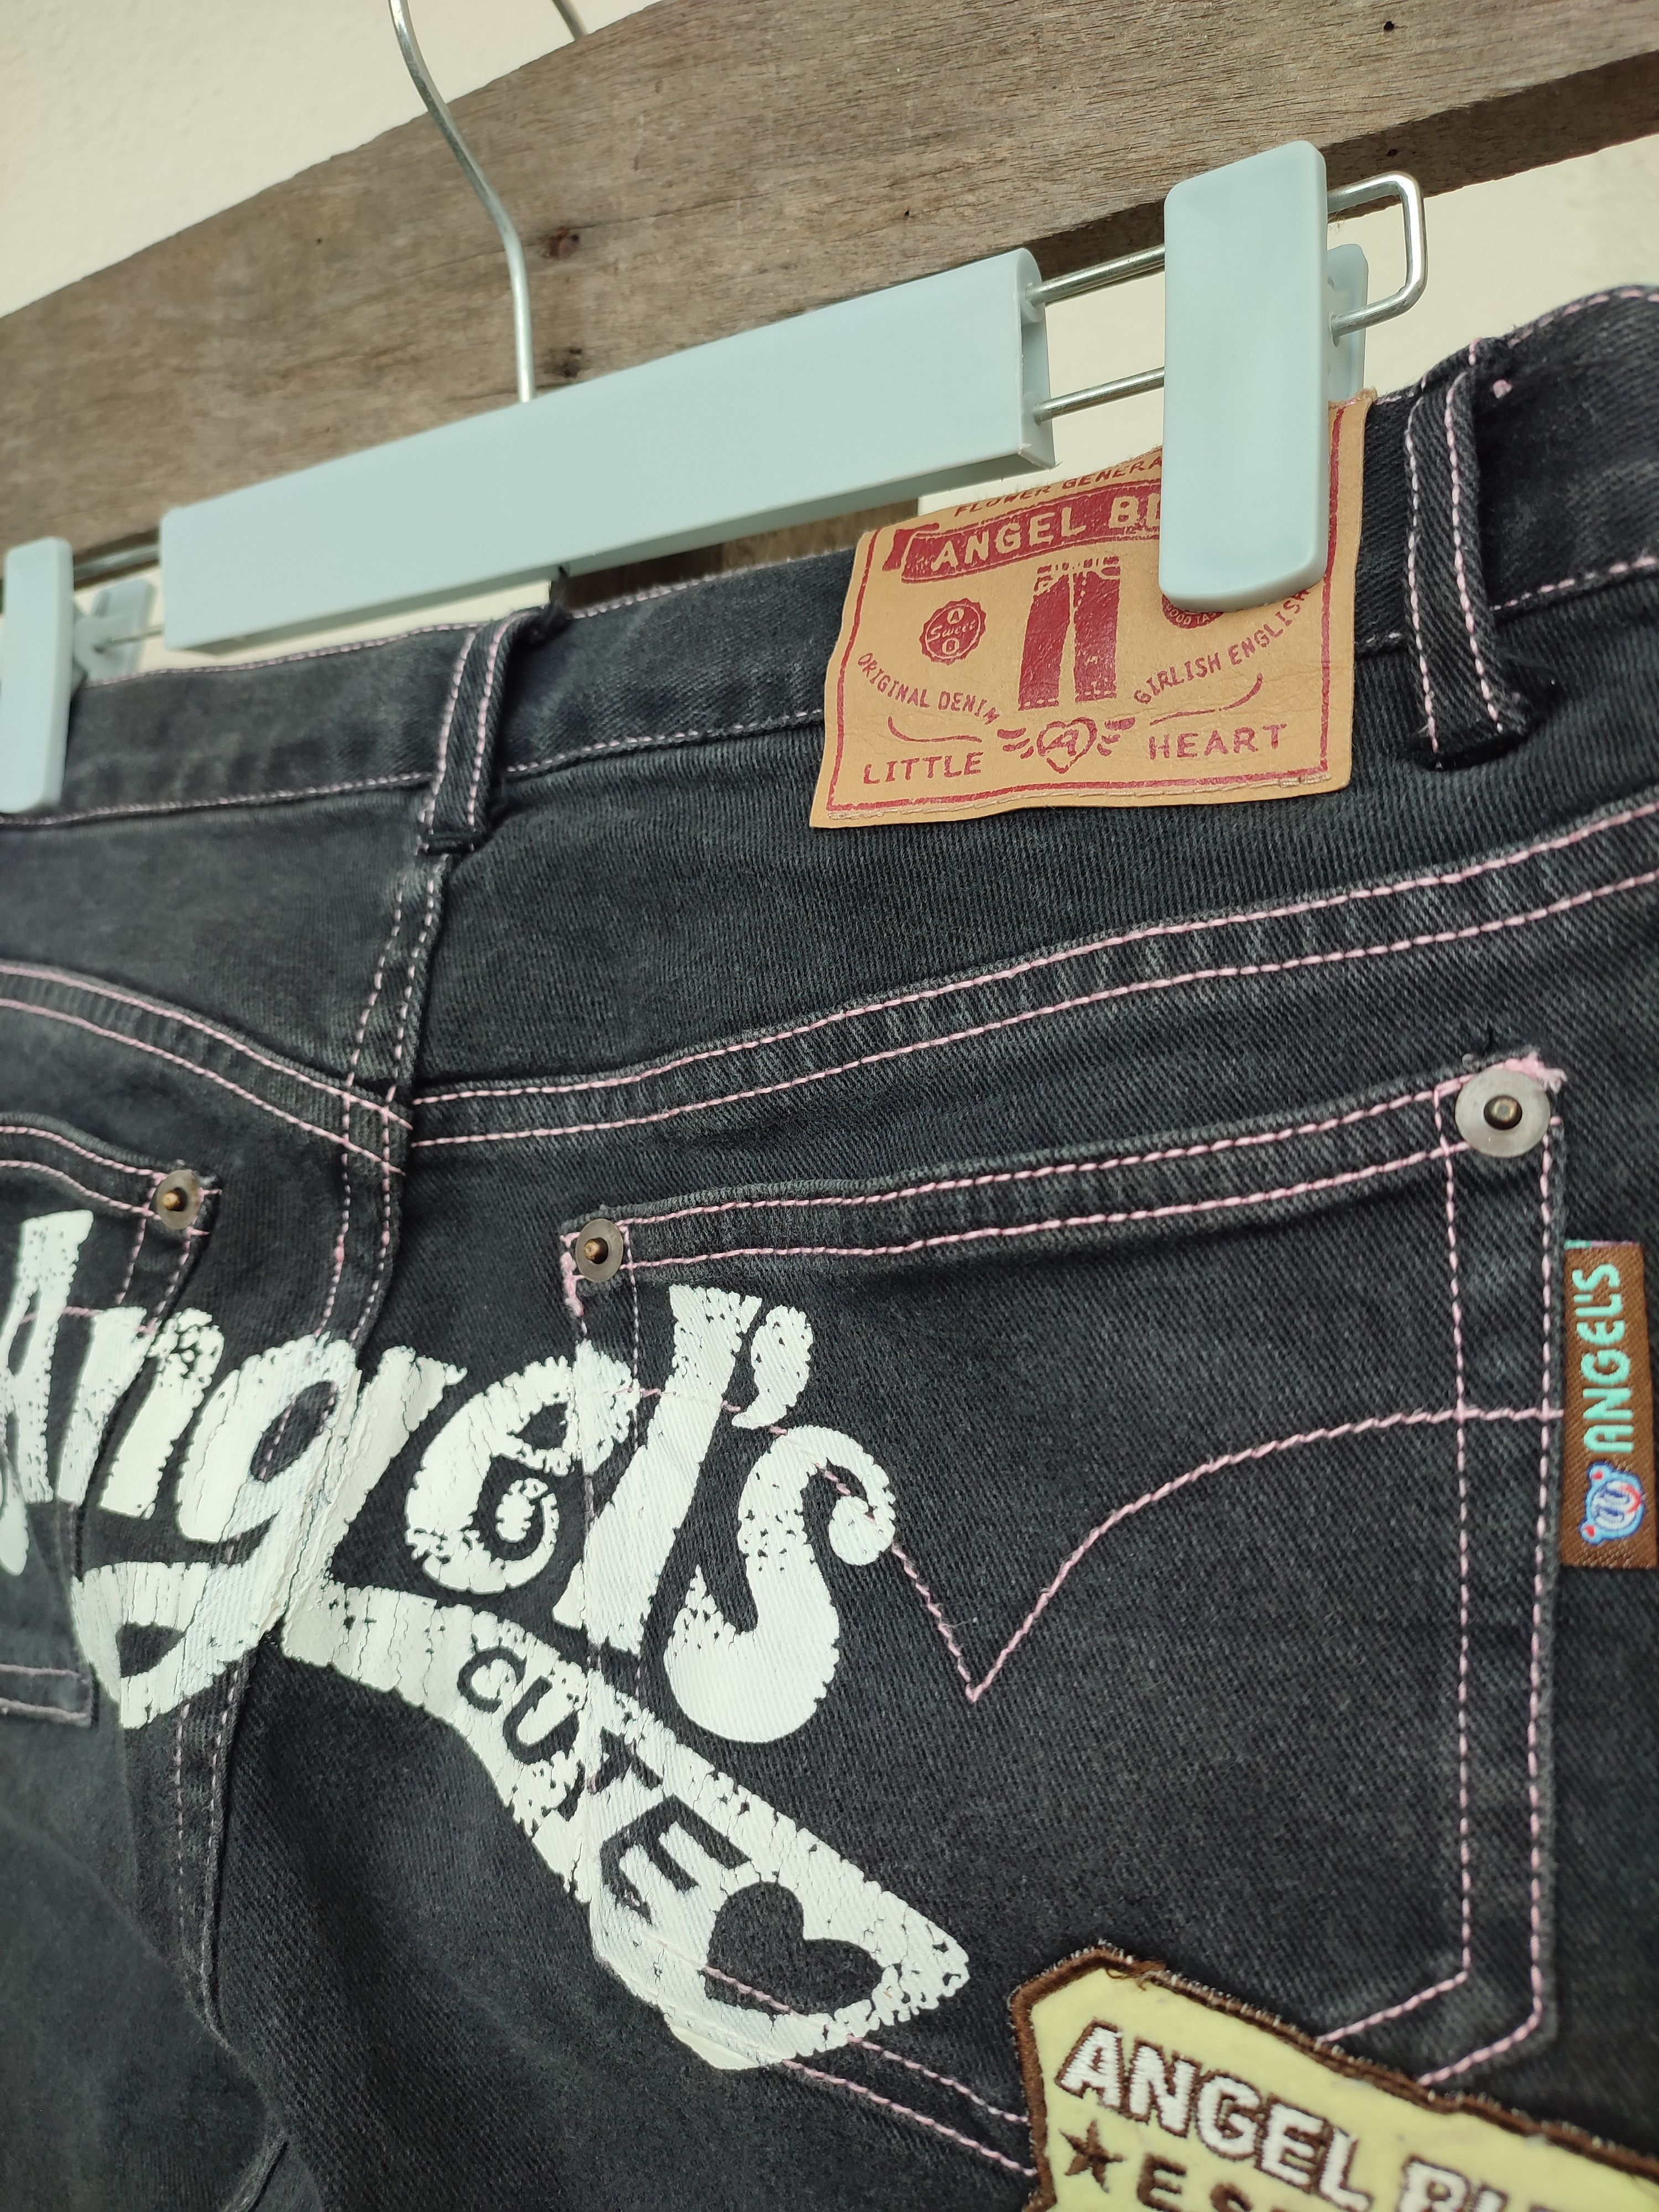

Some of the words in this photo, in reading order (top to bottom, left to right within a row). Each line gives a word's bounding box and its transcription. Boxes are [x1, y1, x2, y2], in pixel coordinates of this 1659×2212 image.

[953, 486, 1051, 517] FLOWER
[1061, 456, 1162, 489] GENERA
[930, 507, 1086, 572] ANGEL
[858, 653, 930, 708] ORIGINAL
[938, 691, 1000, 725] DENIM
[1134, 652, 1222, 705] GIRLISH
[863, 752, 984, 784] LITTLE
[1149, 724, 1288, 760] HEART
[1572, 1262, 1635, 1454] ANGEL'S
[457, 1645, 752, 1926] CUTE
[1055, 2017, 1374, 2212] ANGEL
